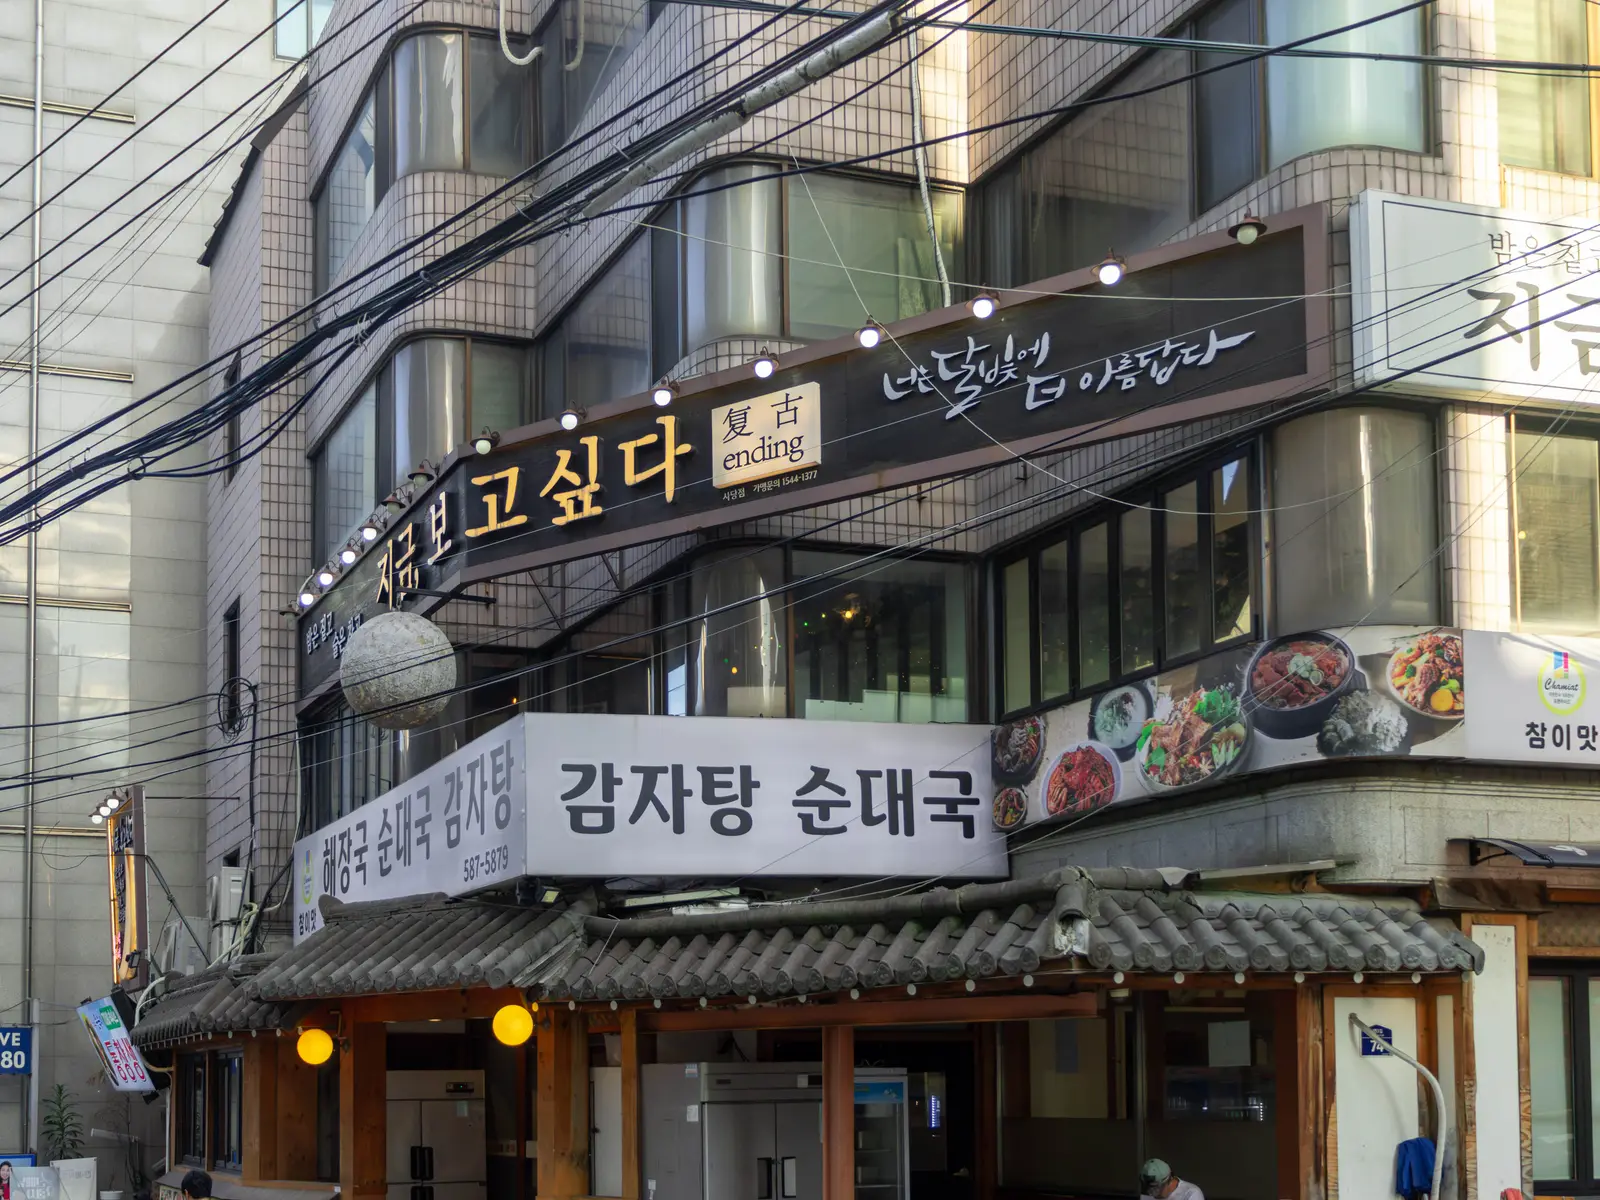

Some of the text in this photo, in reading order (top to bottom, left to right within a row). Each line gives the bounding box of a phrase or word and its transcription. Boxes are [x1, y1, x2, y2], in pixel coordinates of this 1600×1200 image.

[1025, 328, 1257, 411] 더 아름답다
[723, 435, 804, 471] ending
[722, 488, 746, 502] 사당점
[782, 469, 818, 487] 1544-1377
[1525, 721, 1599, 752] 참이맛
[323, 739, 515, 896] 해장국 순대국 감자탕
[560, 763, 981, 840] 감자탕 순대국
[463, 844, 509, 883] 587-5879
